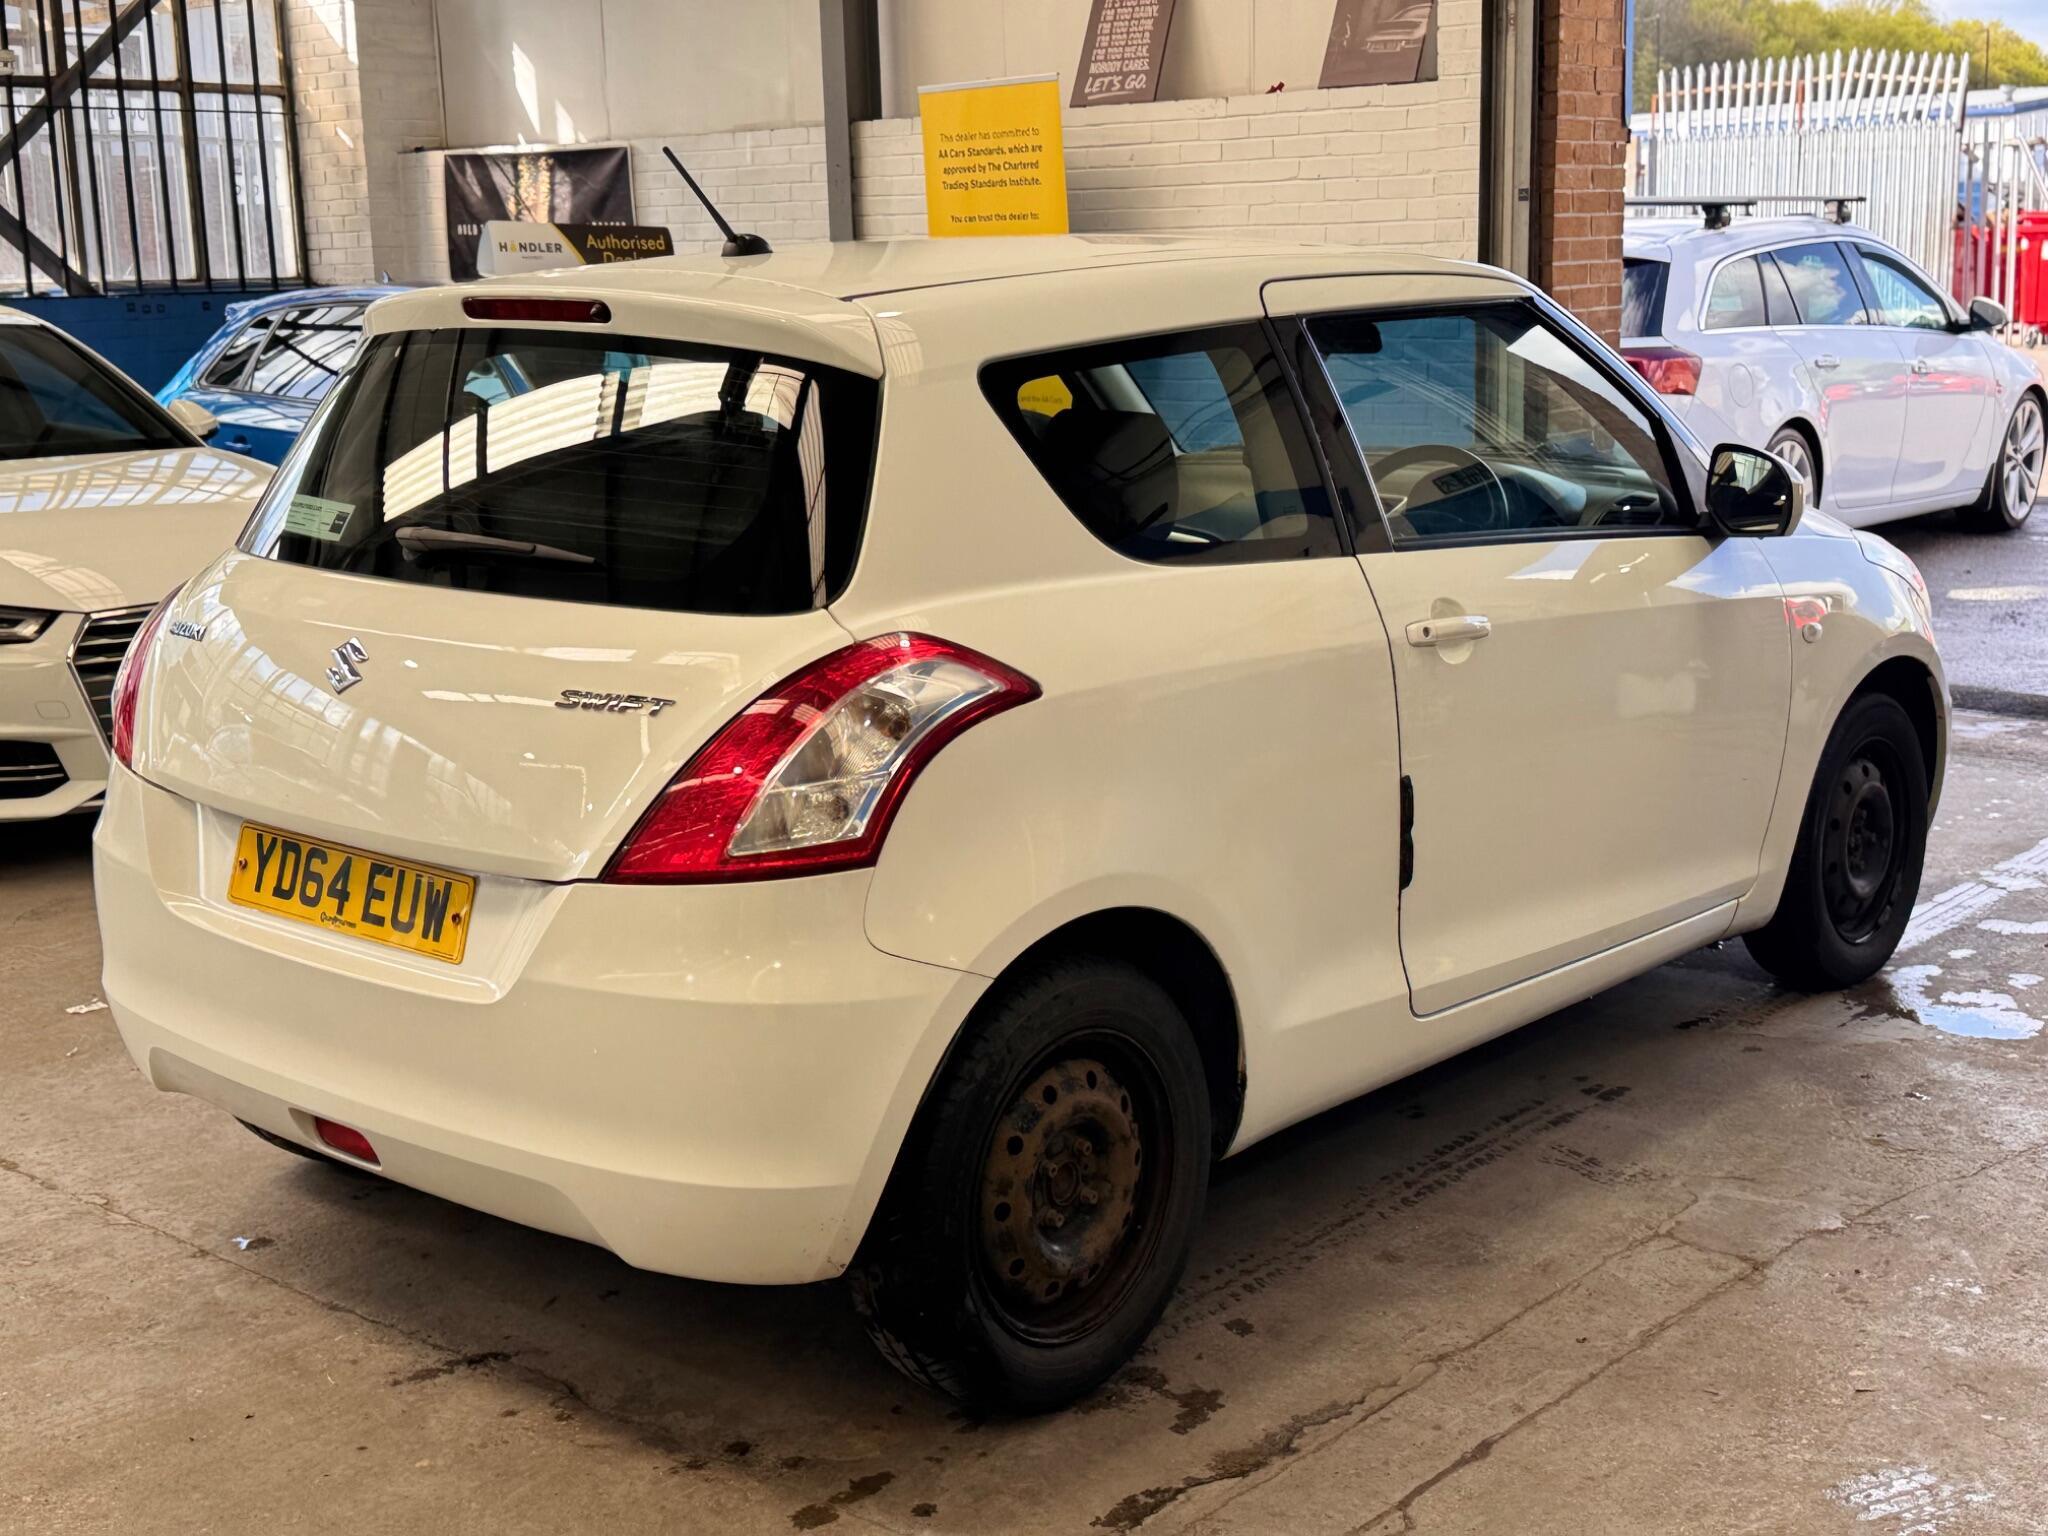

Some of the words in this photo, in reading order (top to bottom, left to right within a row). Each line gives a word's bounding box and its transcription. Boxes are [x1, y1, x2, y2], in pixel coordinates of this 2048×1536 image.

[1116, 7, 1133, 20] TOO
[1112, 20, 1129, 33] TOO
[1111, 34, 1127, 46] TOO
[1107, 47, 1123, 60] TOO
[1089, 61, 1122, 74] NOBODY
[1084, 75, 1122, 93] LET'S
[1124, 73, 1146, 89] GO.
[940, 133, 954, 142] This
[955, 132, 976, 142] dealer
[978, 131, 990, 140] has
[992, 128, 1030, 139] committed
[1032, 127, 1040, 136] to
[938, 149, 948, 158] AA
[950, 149, 965, 158] Cars
[968, 146, 1006, 156] Standards,
[1008, 143, 1029, 154] which
[1031, 144, 1042, 153] are
[943, 164, 976, 175] approved
[978, 163, 986, 174] by
[988, 162, 1001, 171] The
[1003, 160, 1039, 171] Chartered
[942, 180, 968, 191] Trading
[970, 178, 1007, 188] Standards
[1009, 177, 1041, 186] Institute.
[951, 215, 962, 223] You
[964, 215, 976, 223] can
[977, 214, 993, 222] trust
[994, 213, 1007, 221] this
[1009, 212, 1028, 221] dealer
[587, 234, 665, 250] Authorised
[170, 621, 208, 642] SUZUKI
[555, 690, 676, 717] SWIFT
[254, 833, 353, 916] YD64
[361, 862, 452, 943] EUW
